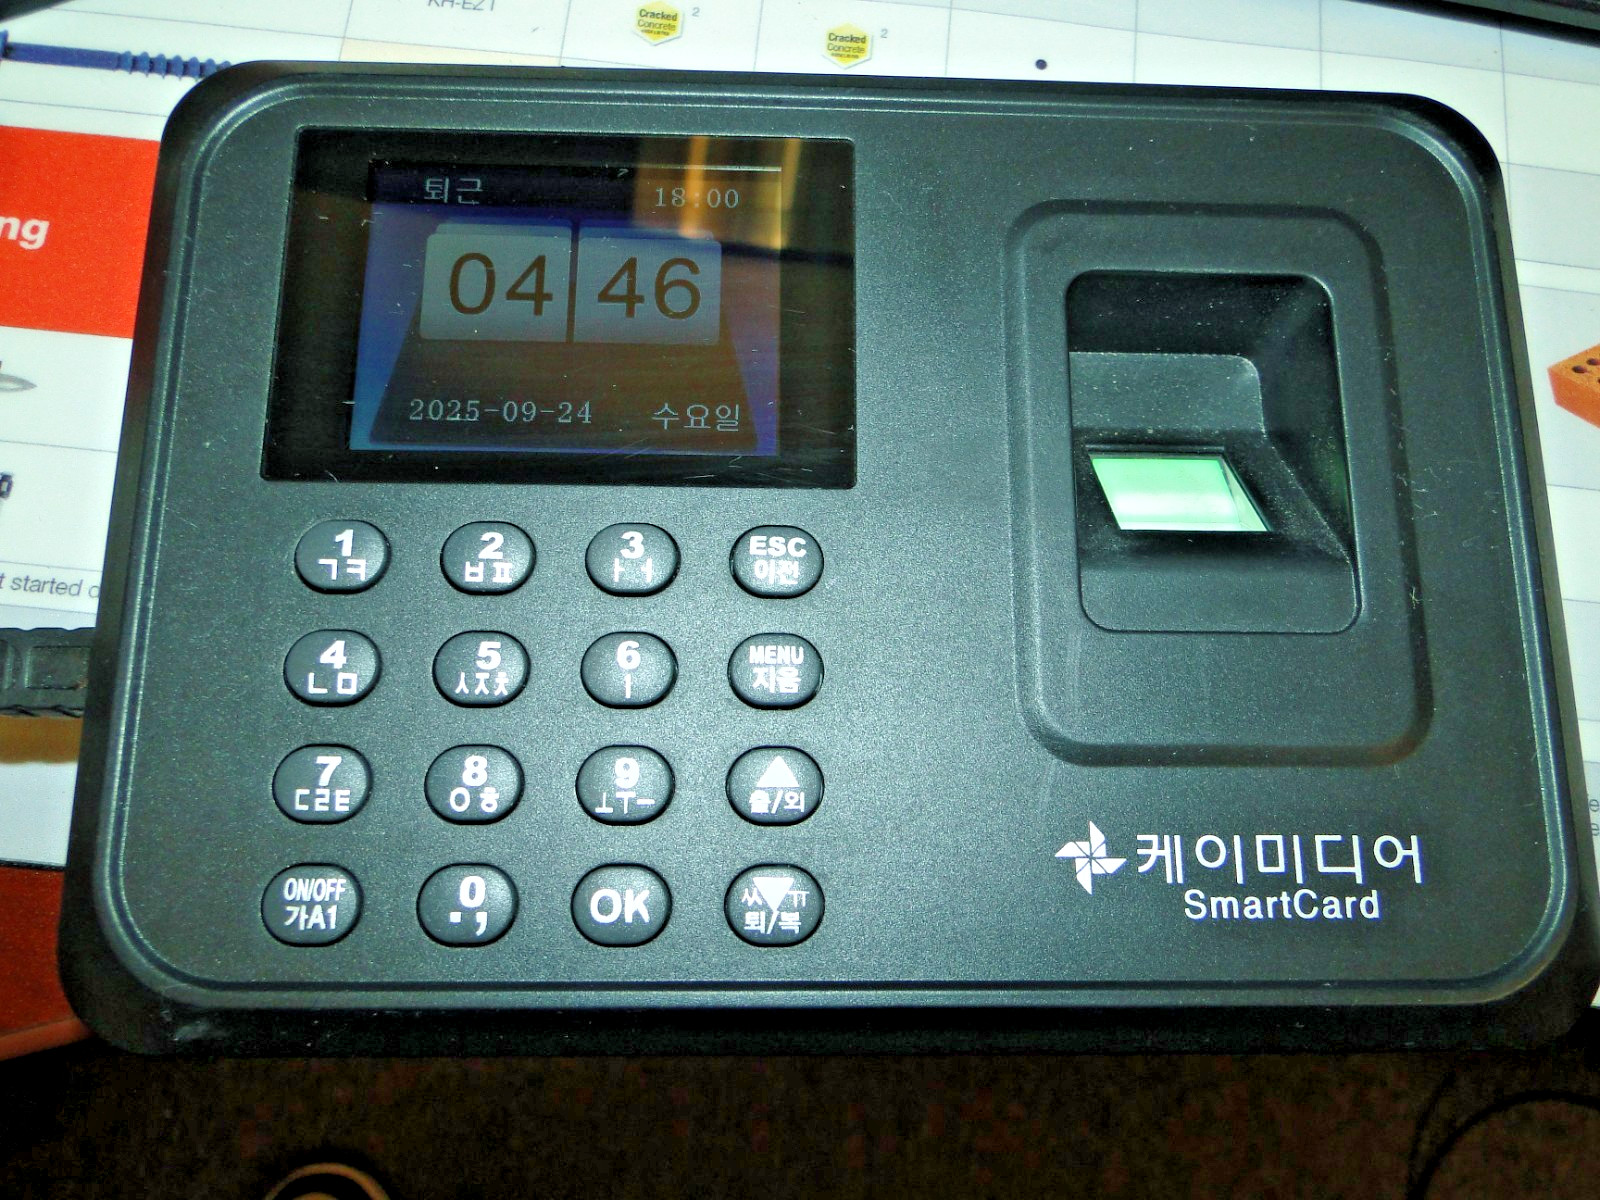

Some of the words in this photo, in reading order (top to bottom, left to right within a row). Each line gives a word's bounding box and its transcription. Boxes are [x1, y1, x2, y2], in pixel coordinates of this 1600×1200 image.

[638, 19, 676, 31] Concrete
[639, 9, 678, 21] Cracked
[692, 7, 700, 17] 2
[827, 43, 866, 53] Concrete
[828, 33, 867, 44] Cracked
[880, 29, 889, 39] 2
[424, 177, 484, 205] 퇴근
[655, 187, 740, 209] 18:00
[448, 252, 553, 317] 04
[597, 256, 701, 320] 46
[408, 398, 593, 425] 2025-09-24
[651, 402, 741, 432] 수요일
[334, 529, 355, 557] 1
[478, 531, 505, 560] 2
[620, 531, 645, 559] 3
[749, 535, 807, 558] ESC
[10, 574, 84, 597] started
[754, 559, 800, 586] 이전
[319, 640, 348, 670] 4
[476, 641, 502, 670] 5
[616, 640, 642, 670] 6
[749, 645, 804, 665] MENU
[752, 666, 802, 694] 지움
[316, 755, 343, 787] 7
[462, 754, 488, 787] 8
[614, 757, 640, 789] 9
[1136, 833, 1423, 885] 케이미디어
[283, 877, 346, 902] ON/OFF
[459, 875, 486, 908] 0
[284, 904, 337, 931] 가A1
[589, 887, 651, 924] OK
[1183, 888, 1382, 921] SmartCard
[744, 910, 802, 935] 퇴/복
